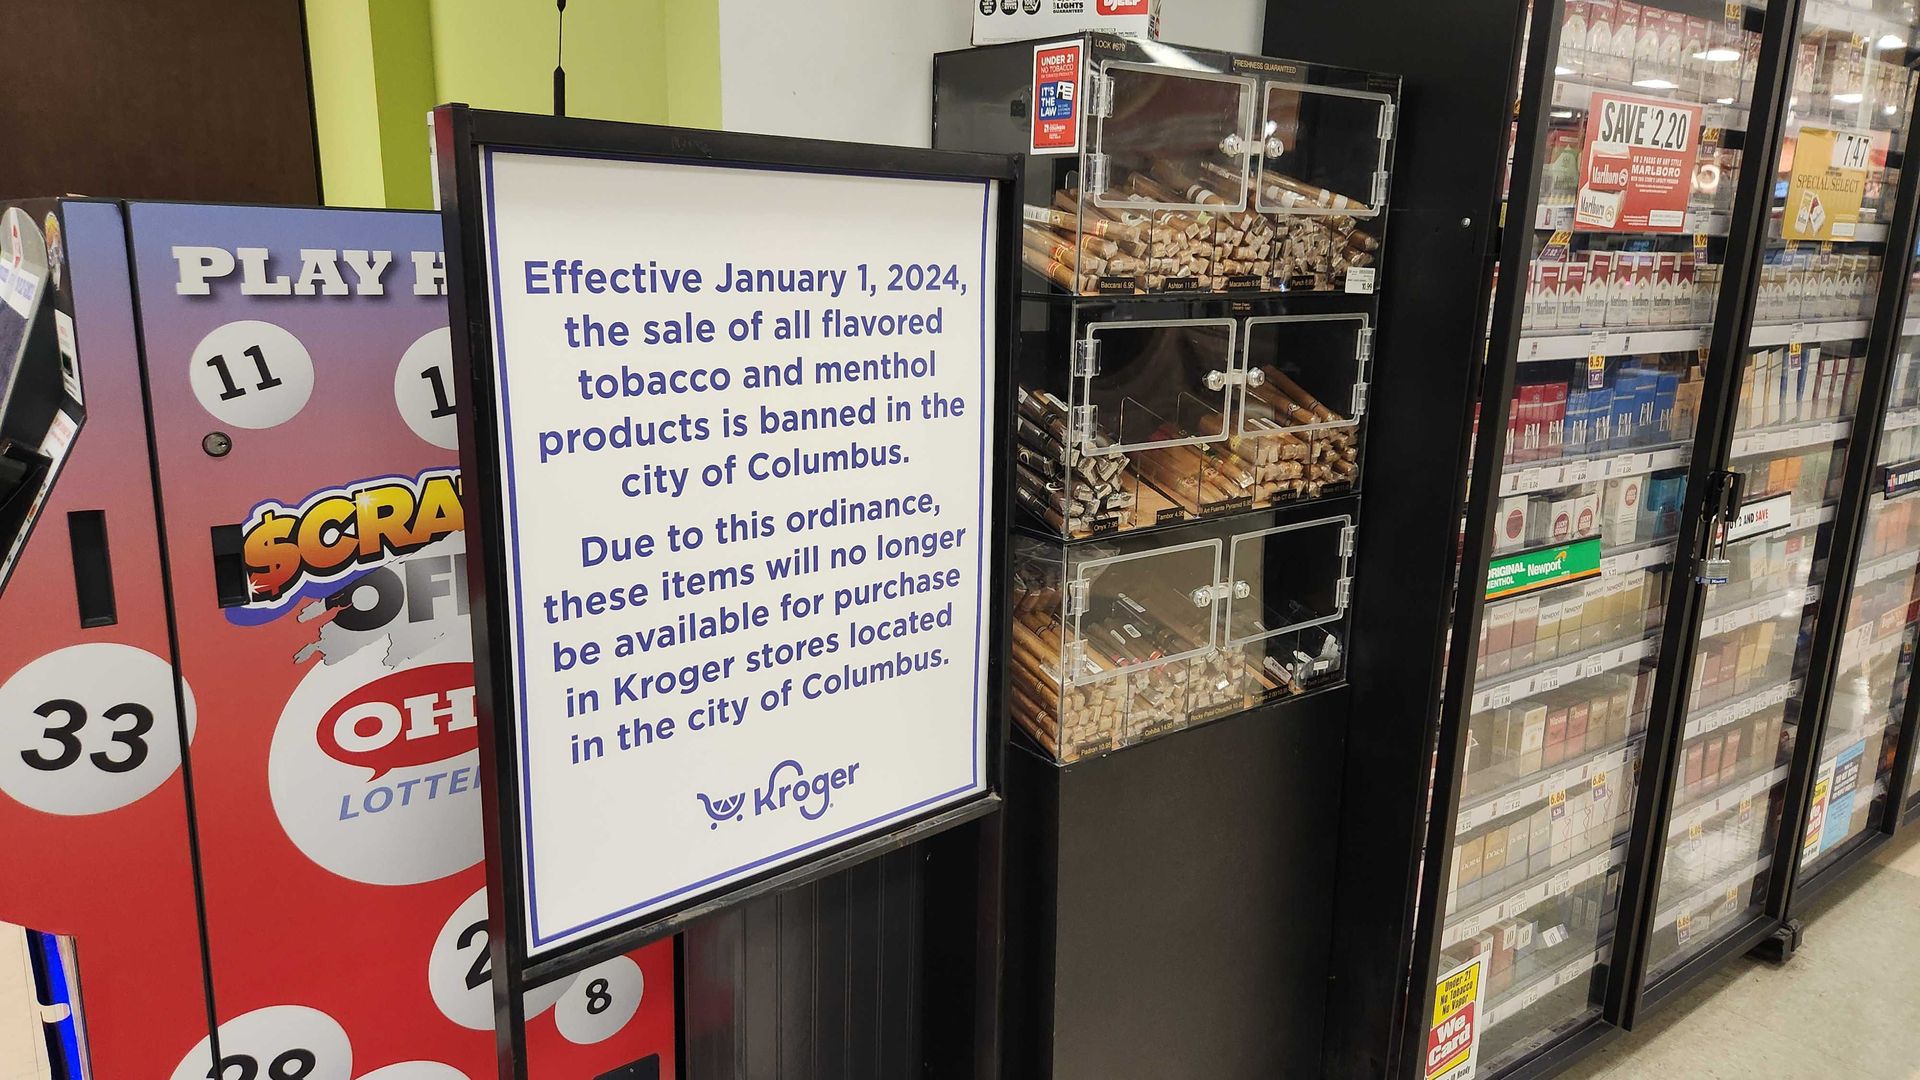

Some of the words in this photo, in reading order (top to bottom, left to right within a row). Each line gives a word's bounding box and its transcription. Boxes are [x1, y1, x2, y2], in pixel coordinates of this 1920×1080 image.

[1095, 39, 1112, 49] LOCK
[1040, 66, 1050, 74] NO
[1050, 63, 1074, 74] TOBACCO
[1041, 54, 1066, 66] UNDER
[1067, 53, 1075, 64] 21
[1234, 58, 1264, 70] FRESHNESS
[1264, 62, 1297, 74] GUARANTEED
[1041, 86, 1055, 96] IT'S
[1040, 106, 1057, 117] LAW
[1041, 97, 1056, 107] THE
[1602, 101, 1648, 145] SAVE
[1844, 135, 1870, 168] 7.47
[1592, 164, 1619, 185] Marlboro
[1631, 165, 1681, 178] MARLBORO
[1796, 174, 1830, 191] SPECIAL
[1830, 179, 1860, 193] SELECT
[1580, 196, 1605, 215] Marlboro
[1550, 231, 1571, 244] 8.92
[1694, 234, 1708, 247] 8.92
[172, 246, 393, 297] PLAY
[411, 251, 448, 296] H
[525, 260, 702, 294] Effective
[716, 263, 845, 297] January
[858, 264, 876, 294] 1,
[888, 264, 966, 293] 2024,
[1100, 281, 1122, 289] Baccarat
[1184, 281, 1198, 289] 11.95
[565, 315, 629, 347] the
[644, 312, 715, 344] sale
[729, 311, 762, 341] of
[775, 310, 809, 339] all
[822, 308, 942, 336] flavored
[1589, 355, 1604, 368] 8.57
[206, 345, 283, 402] 11
[579, 366, 730, 400] tobacco
[743, 358, 802, 388] and
[816, 352, 935, 383] menthol
[420, 365, 456, 419] 1
[540, 416, 709, 463] products
[724, 409, 747, 437] is
[761, 398, 875, 433] banned
[887, 396, 911, 422] in
[922, 393, 964, 419] the
[623, 465, 687, 497] city
[702, 455, 736, 486] of
[748, 443, 908, 480] Columbus.
[1157, 512, 1174, 521] Tambor
[1210, 505, 1225, 513] Fuente
[1225, 501, 1243, 511] Pyramid
[1744, 513, 1755, 524] AND
[1755, 508, 1769, 522] SAVE
[582, 535, 654, 567] Due
[668, 527, 703, 552] to
[716, 512, 774, 544] this
[787, 494, 939, 532] ordinance,
[1093, 523, 1107, 532] Onyx
[1107, 521, 1118, 529] 7.95
[243, 478, 464, 597] $CRA
[544, 584, 648, 624] these
[663, 564, 754, 600] items
[767, 546, 818, 580] will
[831, 545, 866, 568] no
[878, 529, 965, 560] longer
[1528, 559, 1562, 577] Newport
[1606, 581, 1624, 592] Newport
[1627, 576, 1643, 586] Newport
[324, 553, 470, 632] OF
[1586, 586, 1604, 598] Newport
[1518, 604, 1538, 615] Newport
[1541, 609, 1561, 621] Newport
[1564, 603, 1583, 615] Newport
[554, 642, 600, 672] be
[615, 603, 768, 657] available
[781, 594, 823, 620] for
[835, 569, 960, 615] purchase
[567, 688, 598, 717] in
[615, 657, 734, 705] Kroger
[747, 633, 838, 672] stores
[851, 603, 951, 647] located
[572, 736, 603, 763] in
[618, 718, 675, 750] the
[688, 698, 748, 730] city
[761, 680, 791, 710] of
[803, 648, 949, 699] Columbus.
[333, 685, 478, 756] OH
[1144, 726, 1161, 737] Cohiba
[1161, 721, 1174, 732] 14.95
[20, 698, 155, 774] 33
[1081, 746, 1098, 756] Padron
[1593, 773, 1606, 786] 6.86
[339, 766, 483, 822] LOTTE
[754, 760, 859, 820] Kroger
[1551, 791, 1565, 805] 6.86
[456, 918, 494, 992] 2
[1444, 976, 1462, 992] Under
[1463, 970, 1472, 982] 21
[585, 978, 612, 1015] 8
[1440, 994, 1448, 1005] No
[1450, 980, 1474, 999] Tobacco
[1441, 1004, 1450, 1016] No
[1452, 993, 1469, 1010] Vapor
[1437, 1014, 1466, 1044] We
[1428, 1022, 1471, 1067] Card
